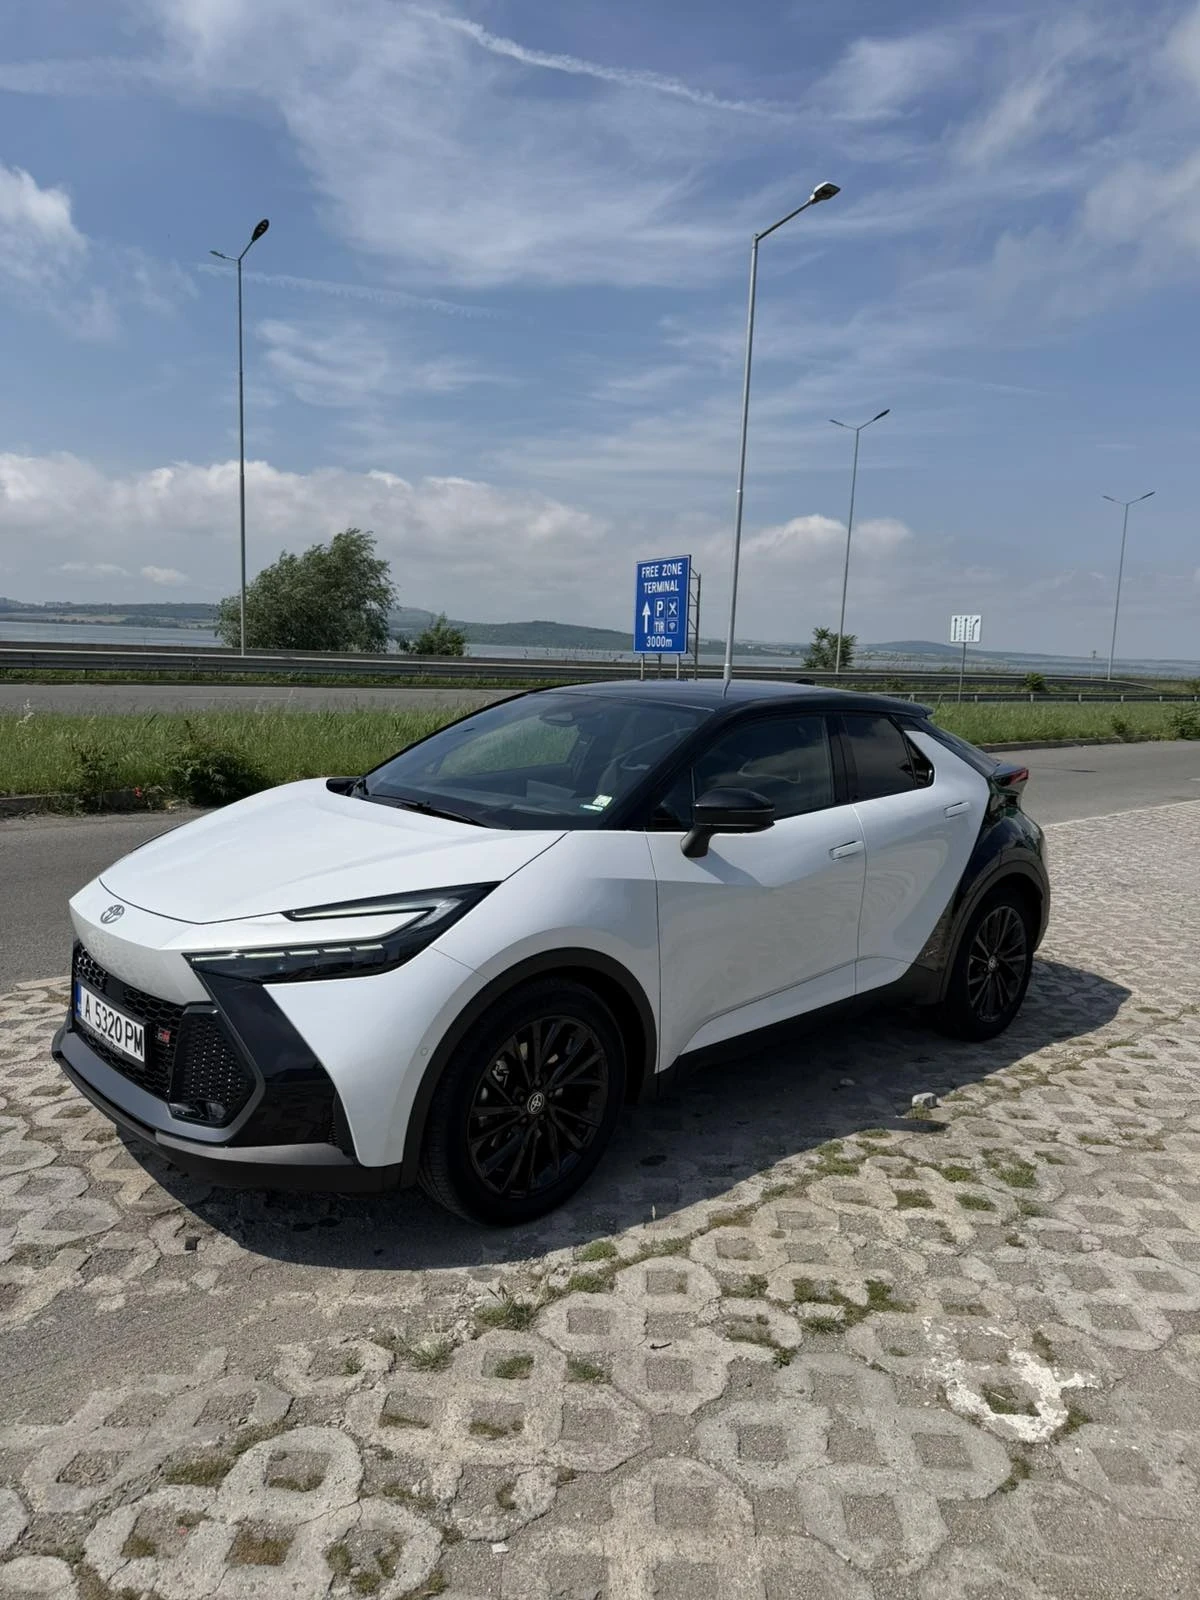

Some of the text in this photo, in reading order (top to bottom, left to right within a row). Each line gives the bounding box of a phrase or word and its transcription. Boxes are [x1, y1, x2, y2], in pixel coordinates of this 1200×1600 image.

[642, 563, 682, 578] FREE ZONE
[643, 580, 679, 593] TERMINAL
[656, 601, 664, 617] P
[655, 622, 665, 633] TIR
[646, 636, 672, 647] 3000m
[85, 994, 91, 1021] A
[95, 1001, 122, 1043] 5320
[125, 1020, 143, 1056] PM
